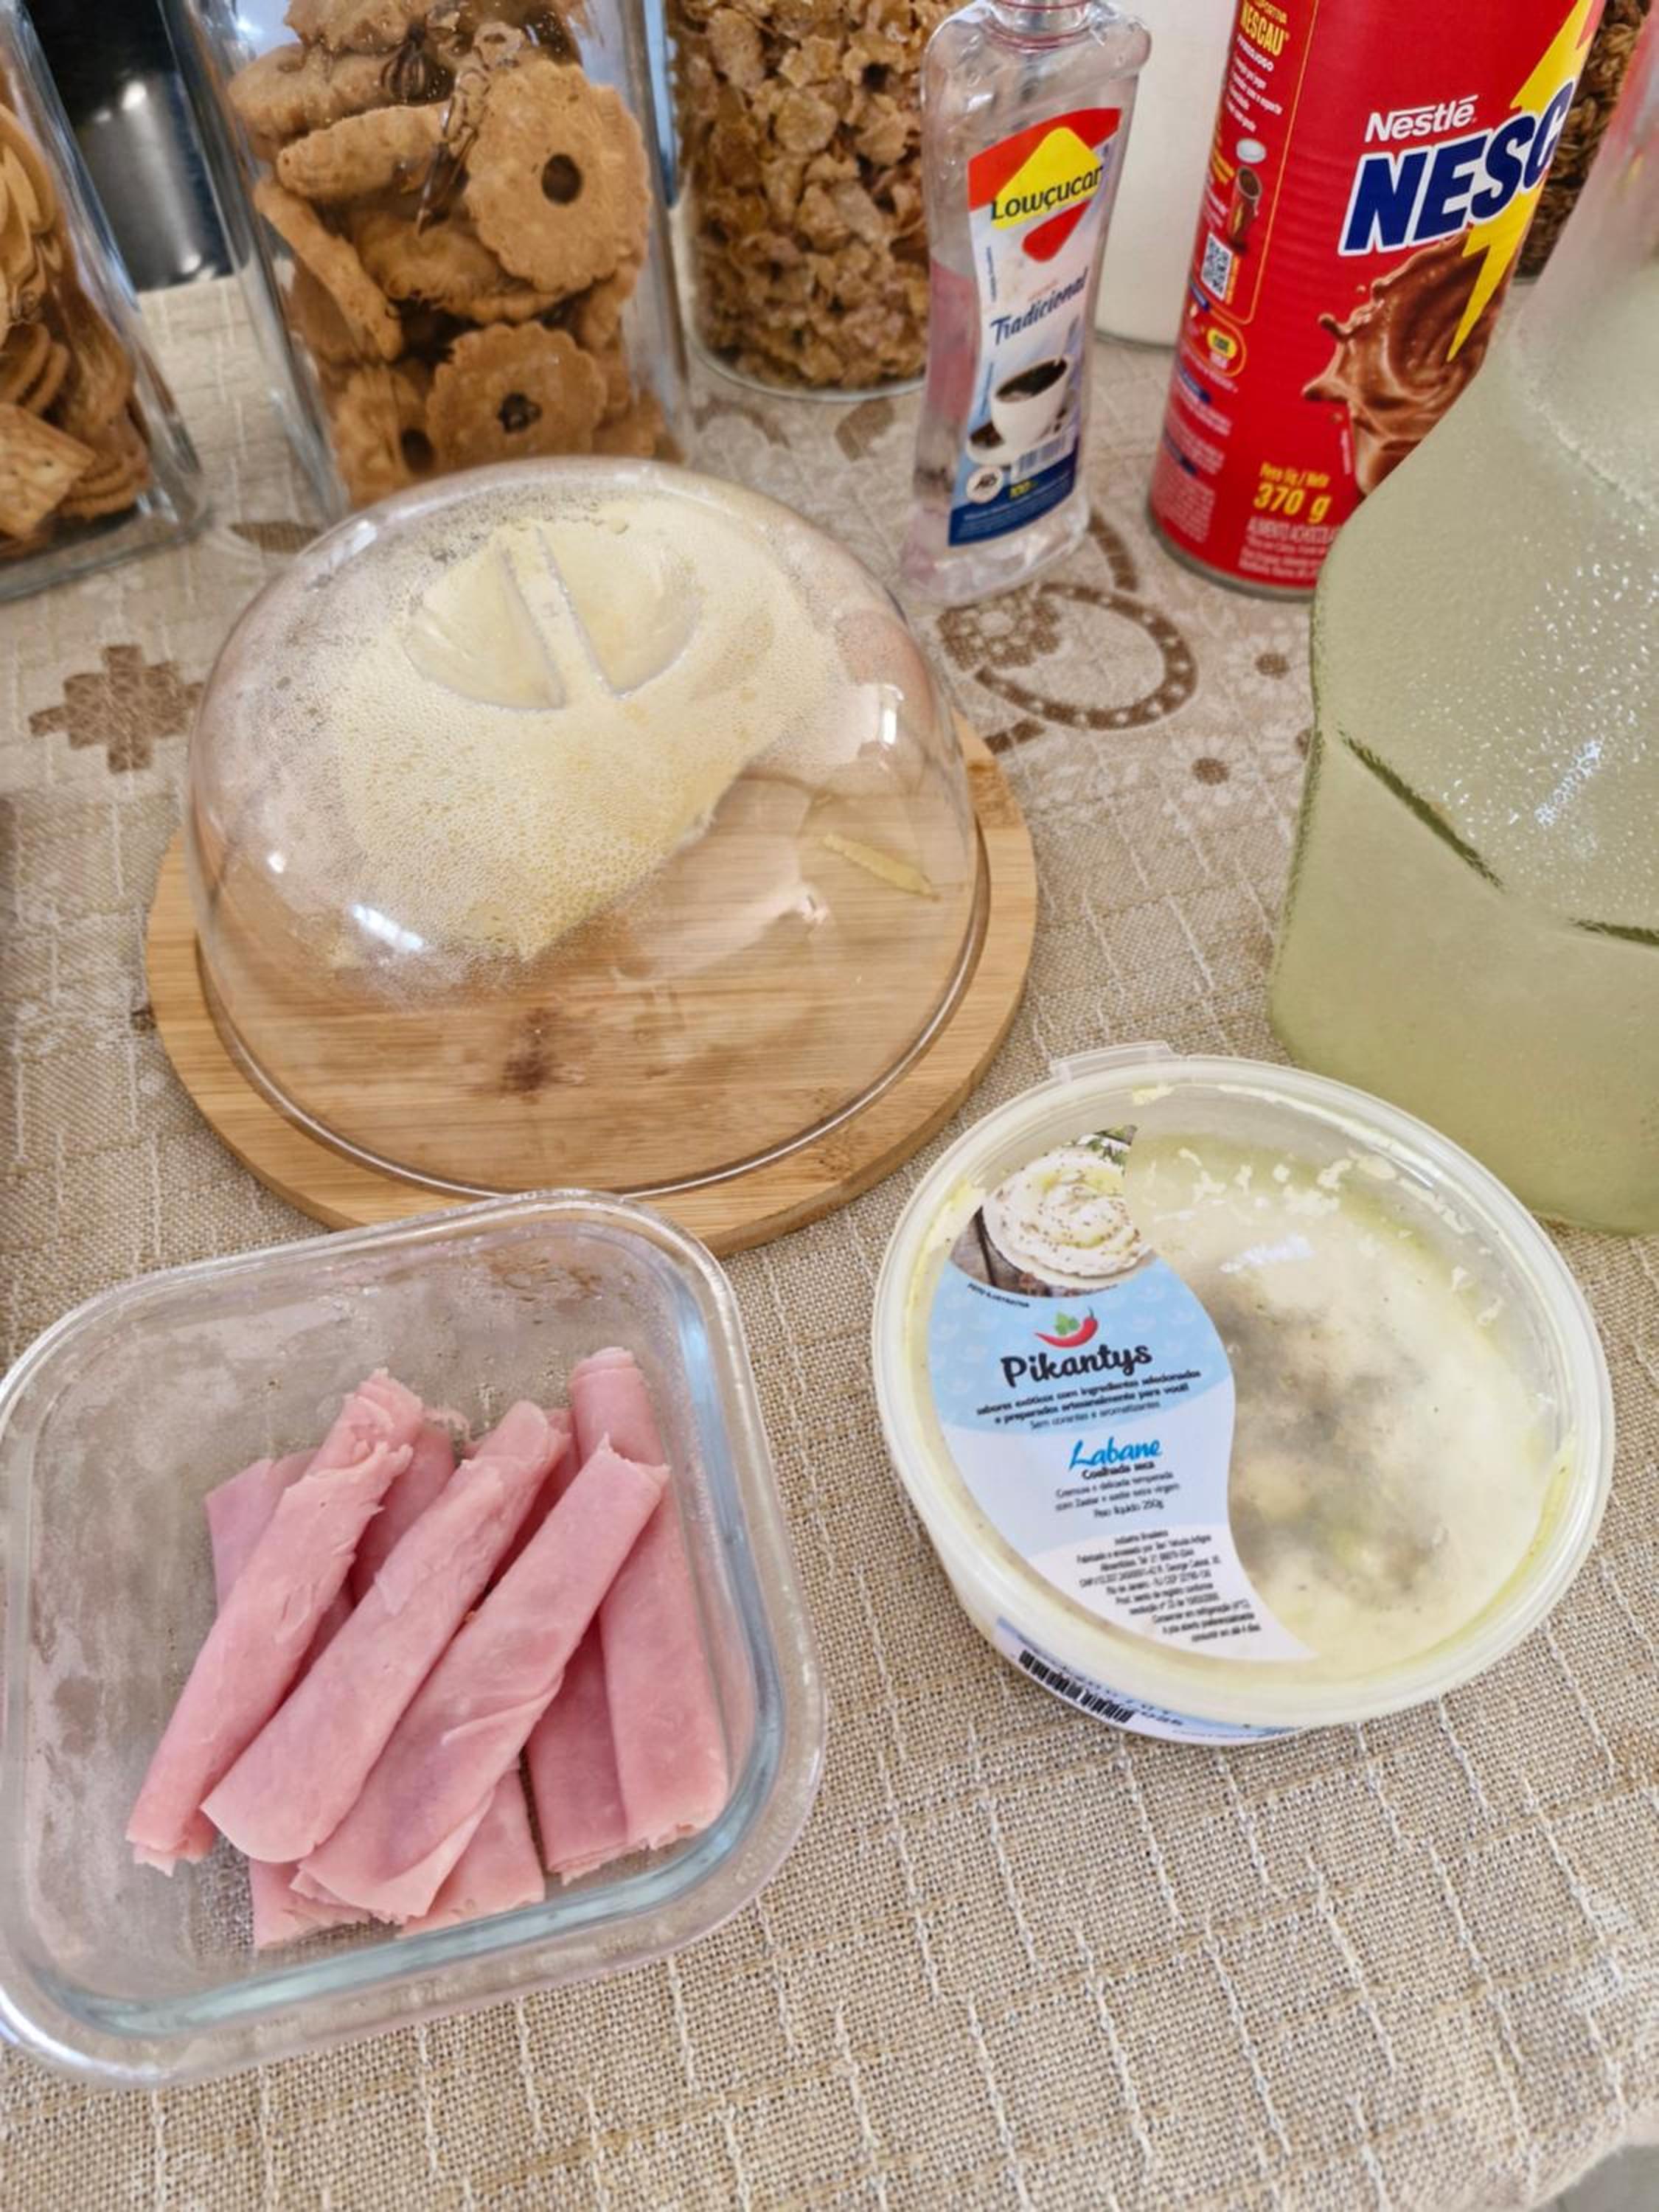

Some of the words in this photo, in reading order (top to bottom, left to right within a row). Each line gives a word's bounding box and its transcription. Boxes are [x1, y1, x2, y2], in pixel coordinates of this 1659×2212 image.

[1365, 94, 1478, 143] Nestlé
[991, 165, 1104, 220] Lowçucar
[990, 266, 1089, 346] Tradicional
[1253, 482, 1305, 515] 370
[1307, 495, 1332, 524] g
[1001, 1343, 1152, 1388] Pikantys
[1068, 1436, 1162, 1470] Labane
